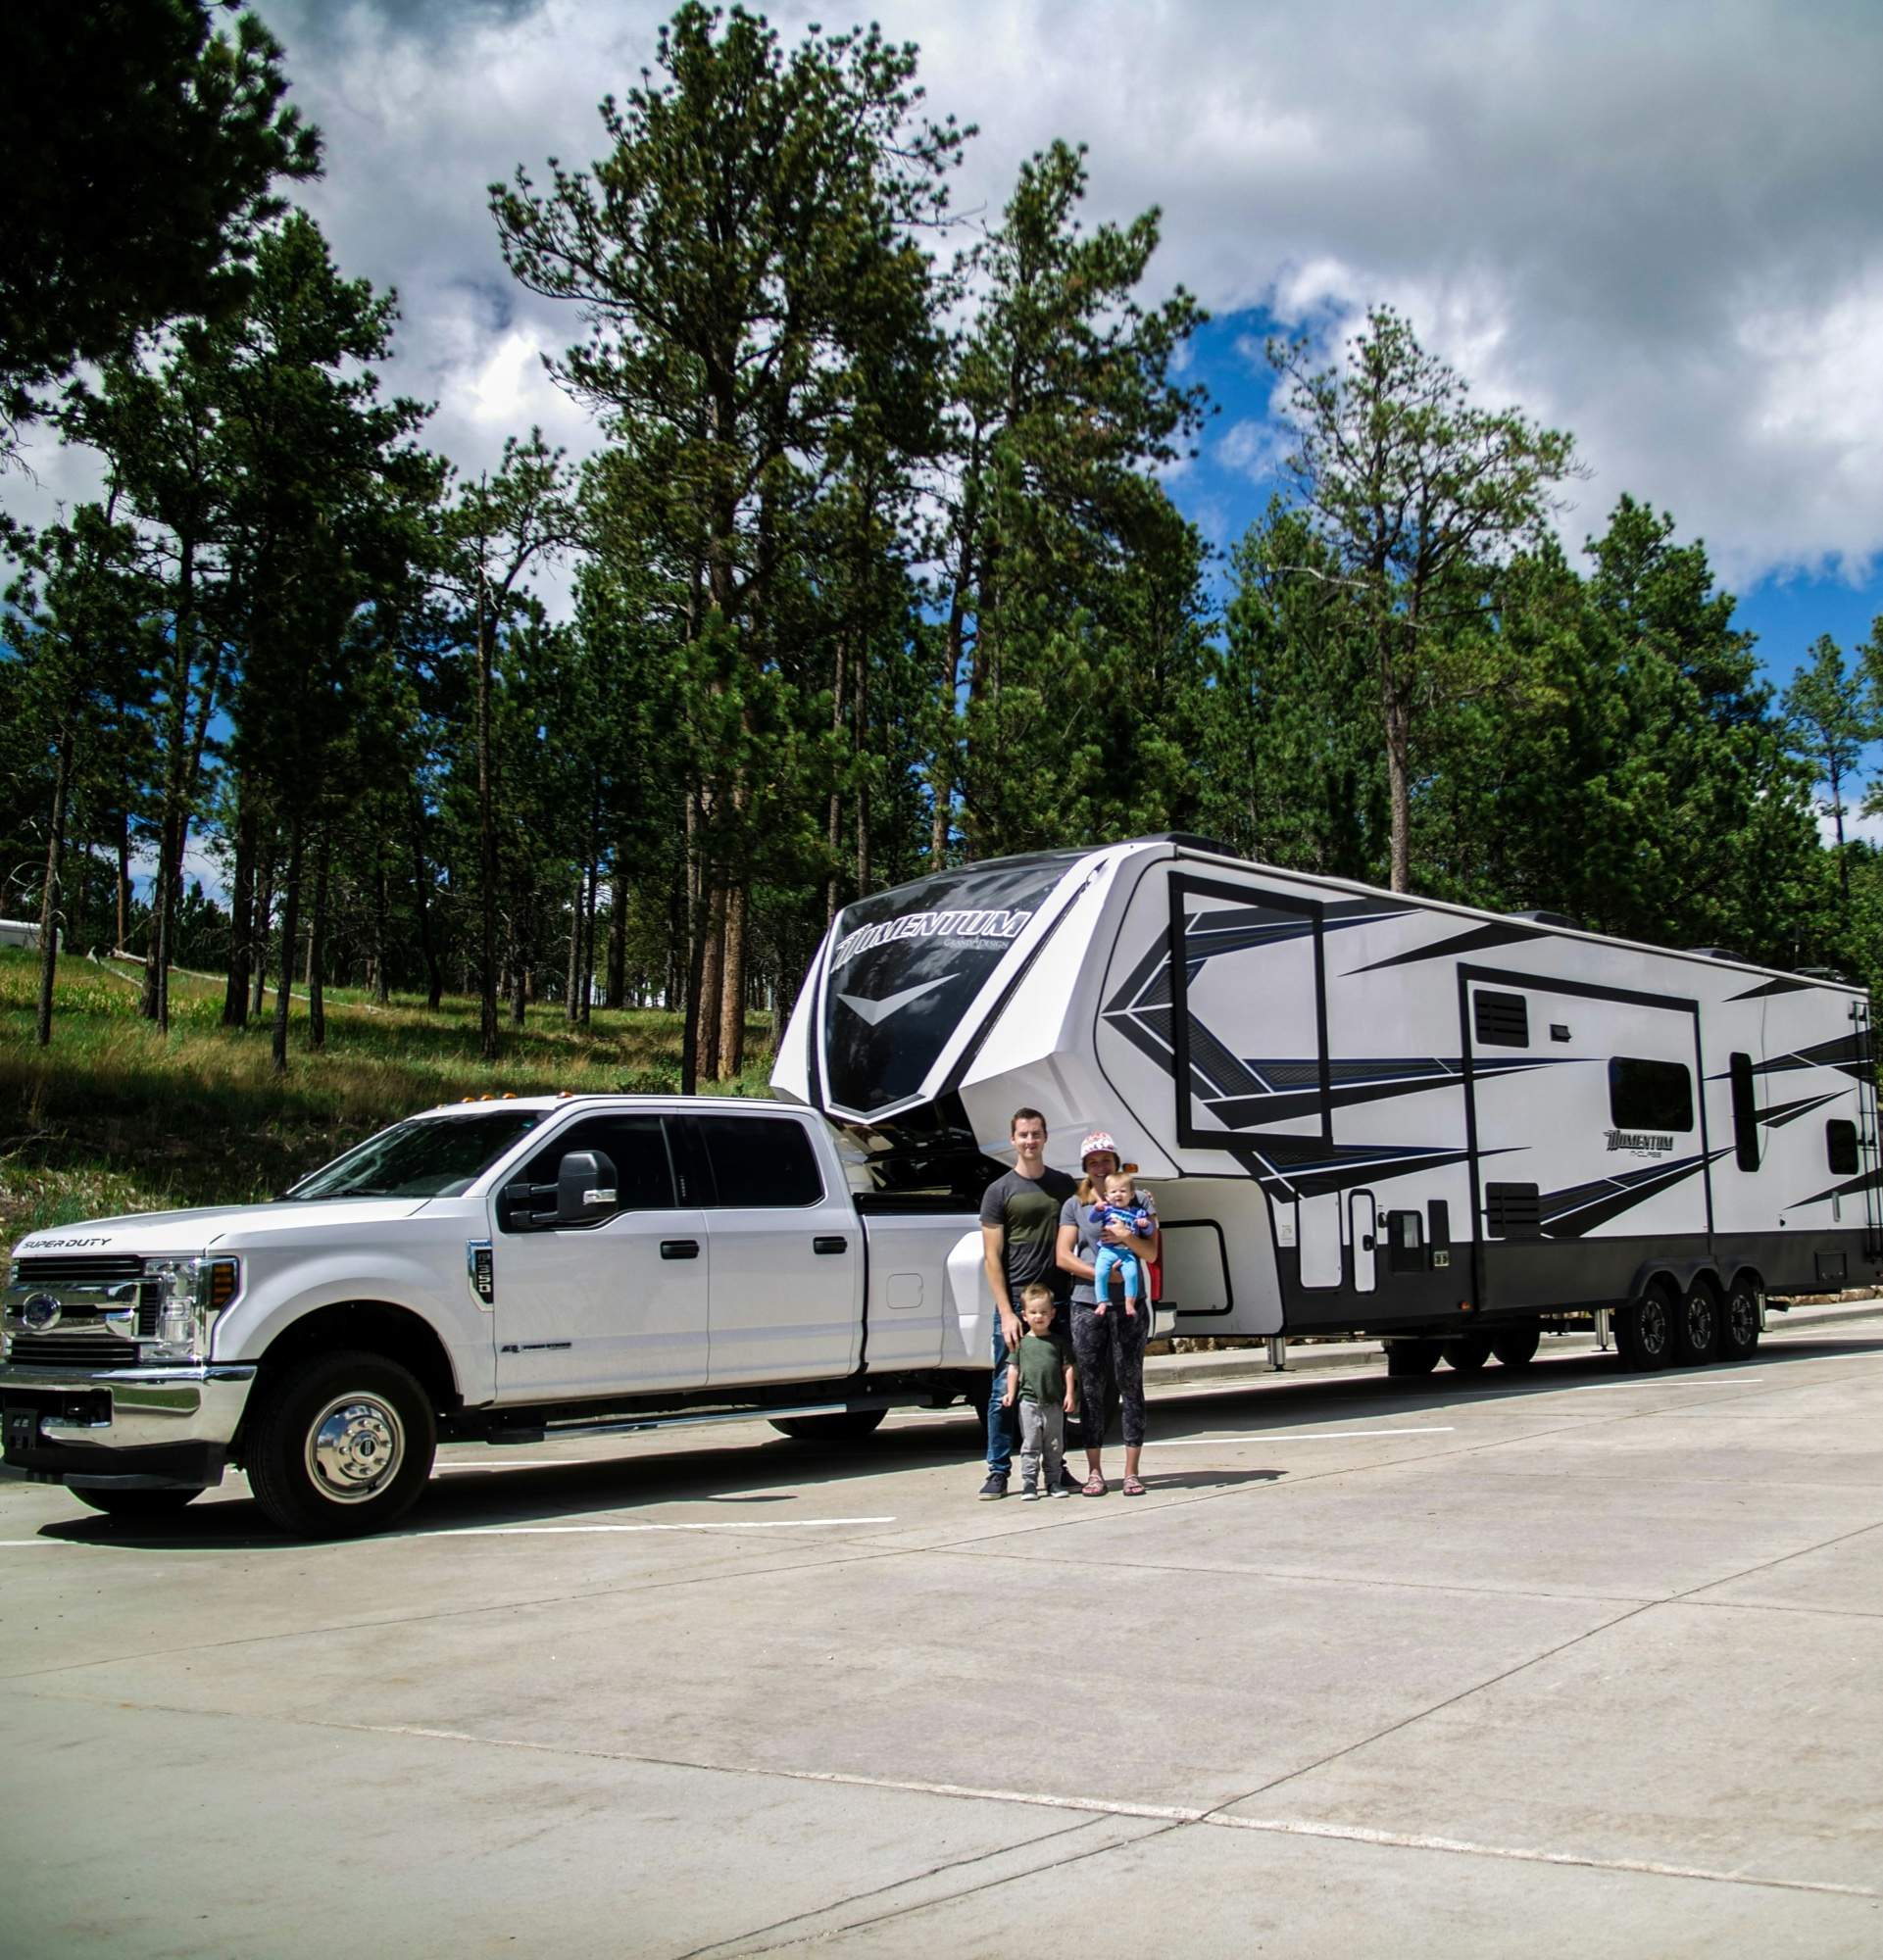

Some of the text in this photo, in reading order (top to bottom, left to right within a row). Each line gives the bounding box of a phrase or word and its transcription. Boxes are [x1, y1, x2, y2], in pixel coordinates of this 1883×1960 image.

[830, 910, 1032, 973] MOMENTUM
[1603, 1130, 1673, 1151] MOMENTUM
[23, 1238, 112, 1249] SUPER DUTY
